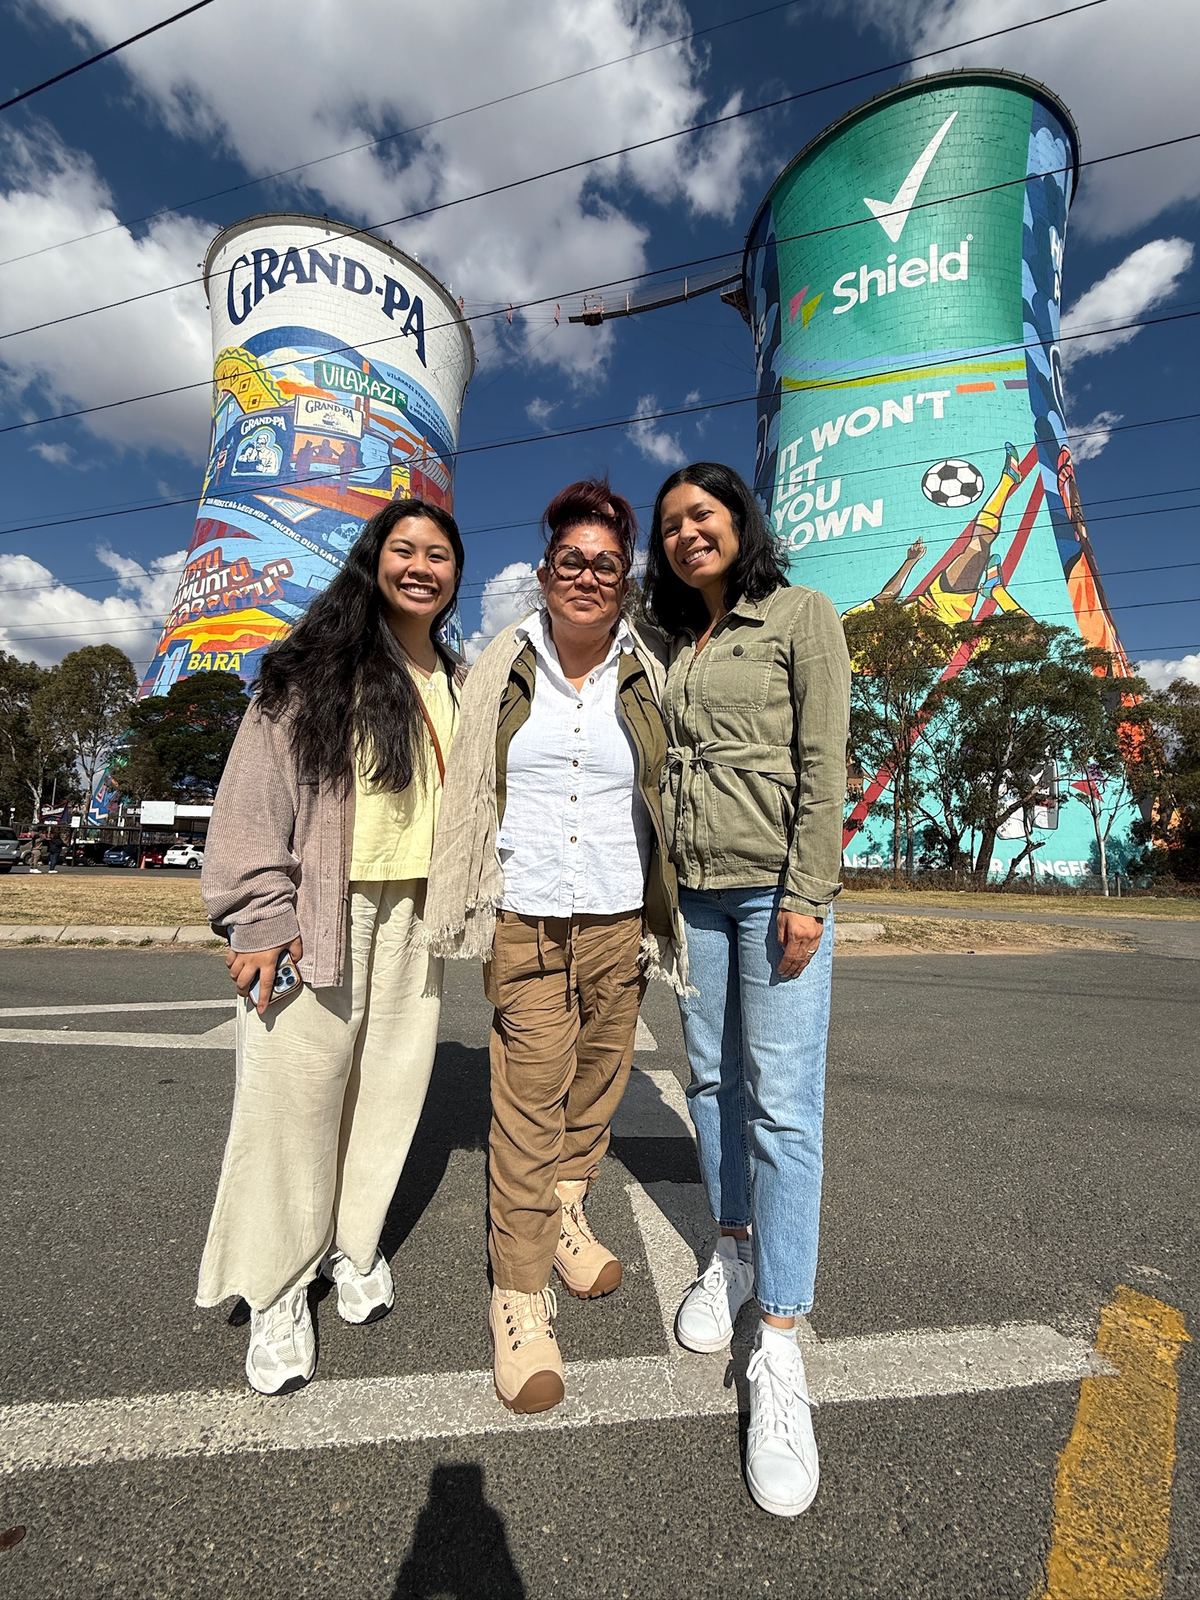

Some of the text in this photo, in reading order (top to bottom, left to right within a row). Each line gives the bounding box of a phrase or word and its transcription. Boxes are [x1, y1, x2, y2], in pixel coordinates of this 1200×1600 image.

[833, 241, 969, 315] Shield
[227, 247, 427, 368] GRAND-PA
[241, 416, 286, 435] GRAND-PA
[305, 399, 354, 423] GRAND-PA
[780, 390, 952, 475] IT WON'T
[773, 478, 841, 532] YOU
[776, 455, 823, 505] LET
[236, 503, 269, 521] LEGENDS
[270, 519, 301, 541] PAVING
[300, 537, 320, 553] OUR
[187, 653, 241, 671] BARA
